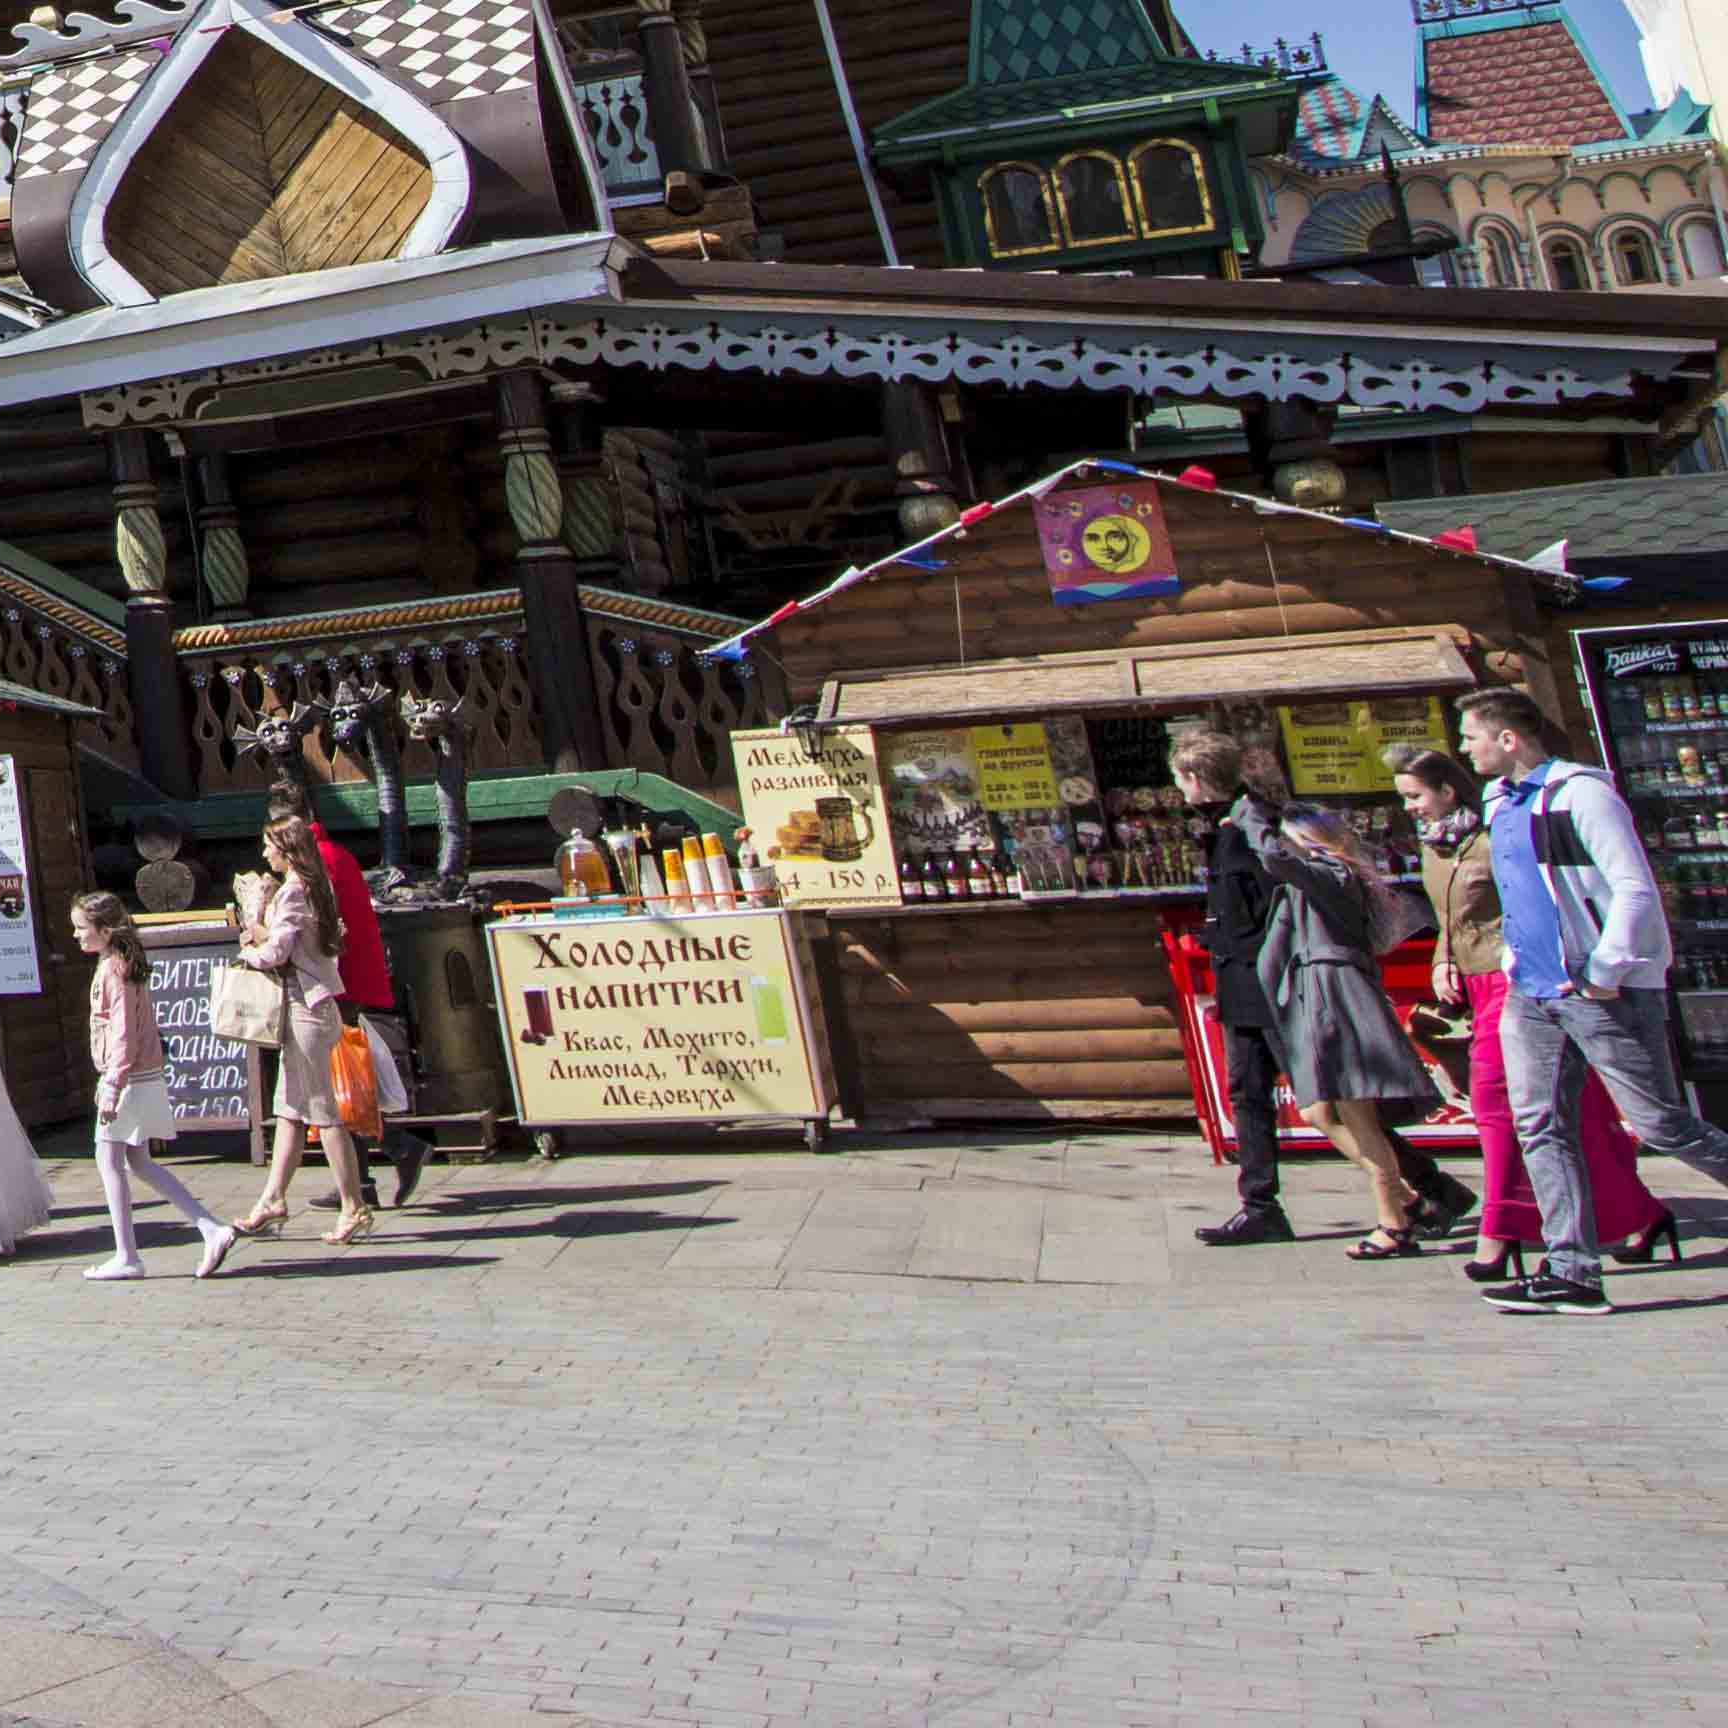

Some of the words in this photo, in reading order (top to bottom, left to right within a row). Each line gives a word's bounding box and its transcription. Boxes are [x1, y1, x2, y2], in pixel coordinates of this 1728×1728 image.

[1603, 642, 1680, 672] Байкал
[751, 772, 869, 796] разливная
[824, 869, 865, 889] 150
[874, 873, 893, 893] р.
[530, 931, 753, 973] Холодные
[555, 978, 744, 1011] напитки
[563, 1030, 632, 1054] Квас,
[643, 1026, 756, 1055] Мохито,
[549, 1058, 667, 1082] Лимонад,
[676, 1053, 782, 1082] Тархун,
[602, 1084, 736, 1112] Медовуха
